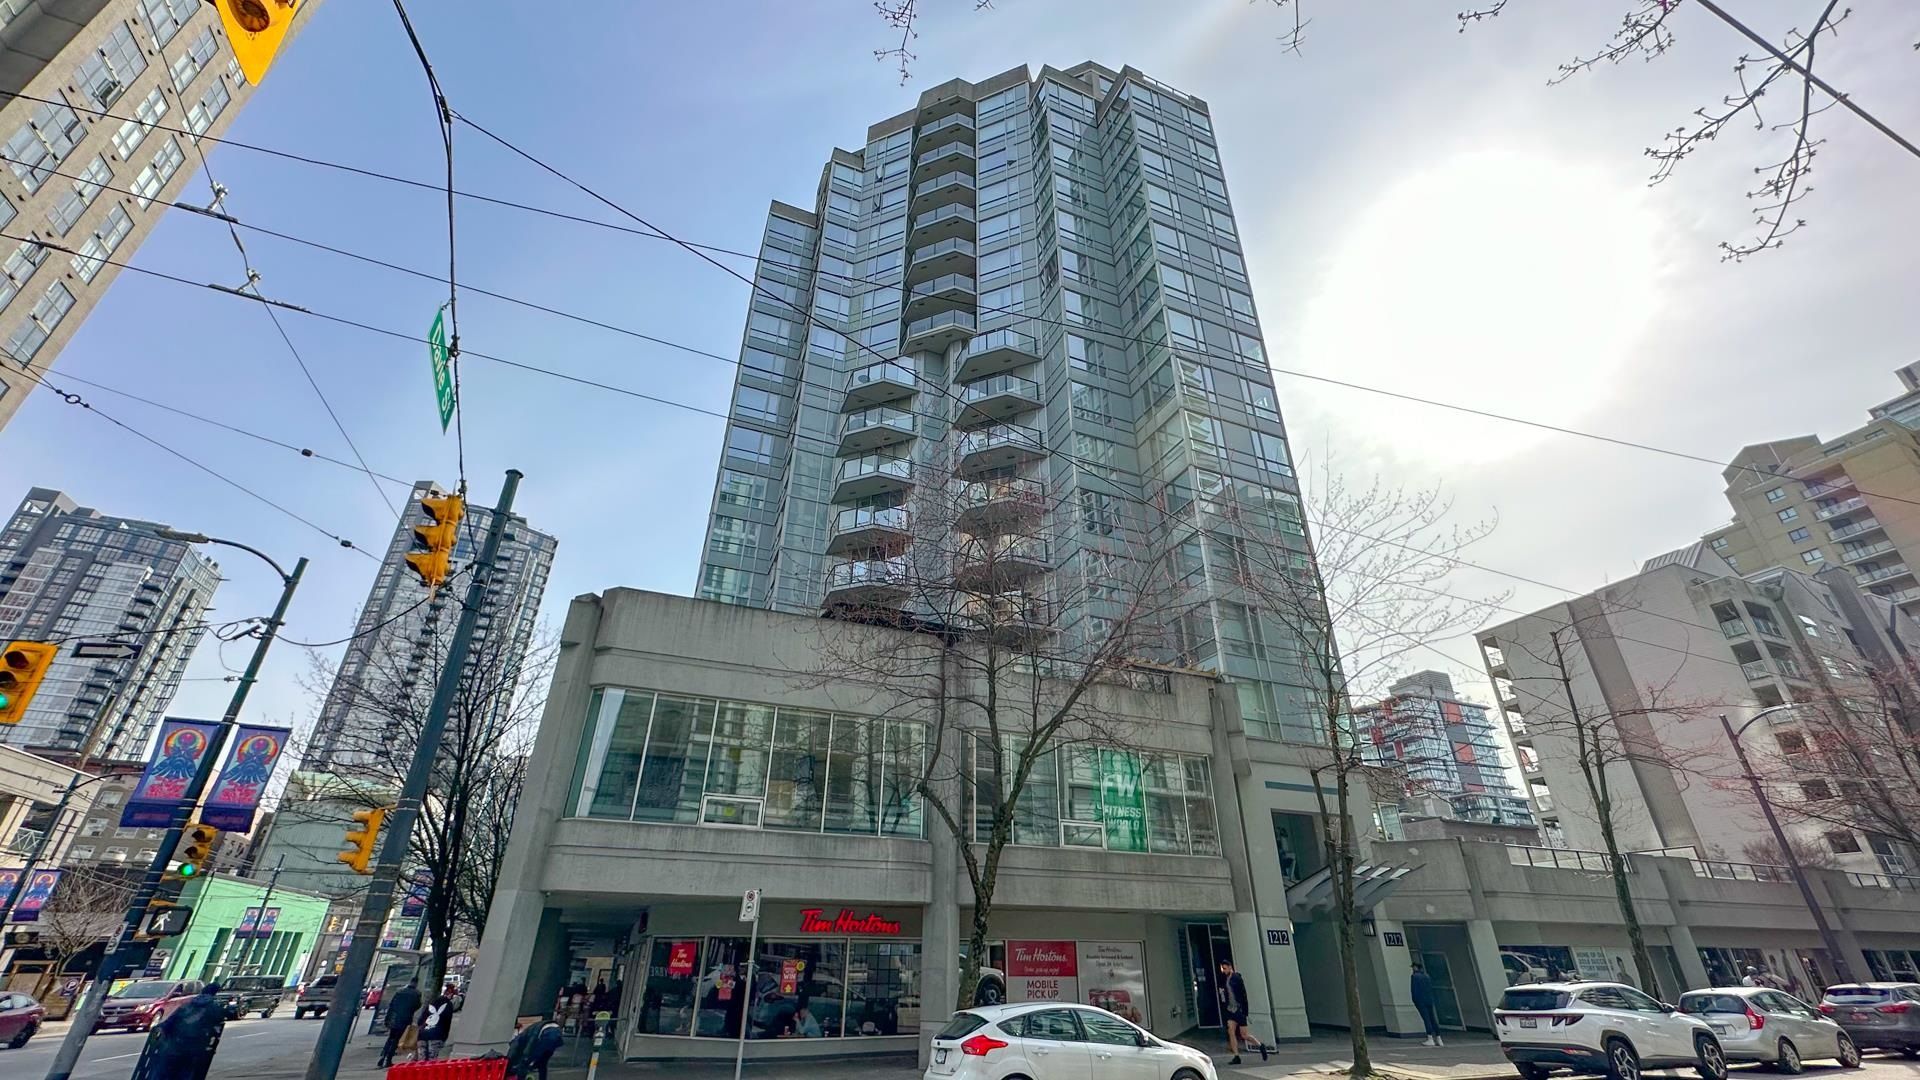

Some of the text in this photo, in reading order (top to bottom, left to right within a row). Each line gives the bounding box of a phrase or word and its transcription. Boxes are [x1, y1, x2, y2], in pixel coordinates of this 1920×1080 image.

[432, 321, 452, 420] Davie St
[1103, 773, 1138, 797] FW
[1104, 805, 1142, 818] FITNESS
[800, 908, 901, 934] Tim Hortons
[1268, 931, 1290, 945] 1212
[1385, 933, 1404, 946] 1212
[1016, 948, 1031, 962] Tim
[783, 972, 797, 980] WIN
[1027, 980, 1059, 989] MOBILE
[1027, 989, 1059, 999] PICK UP
